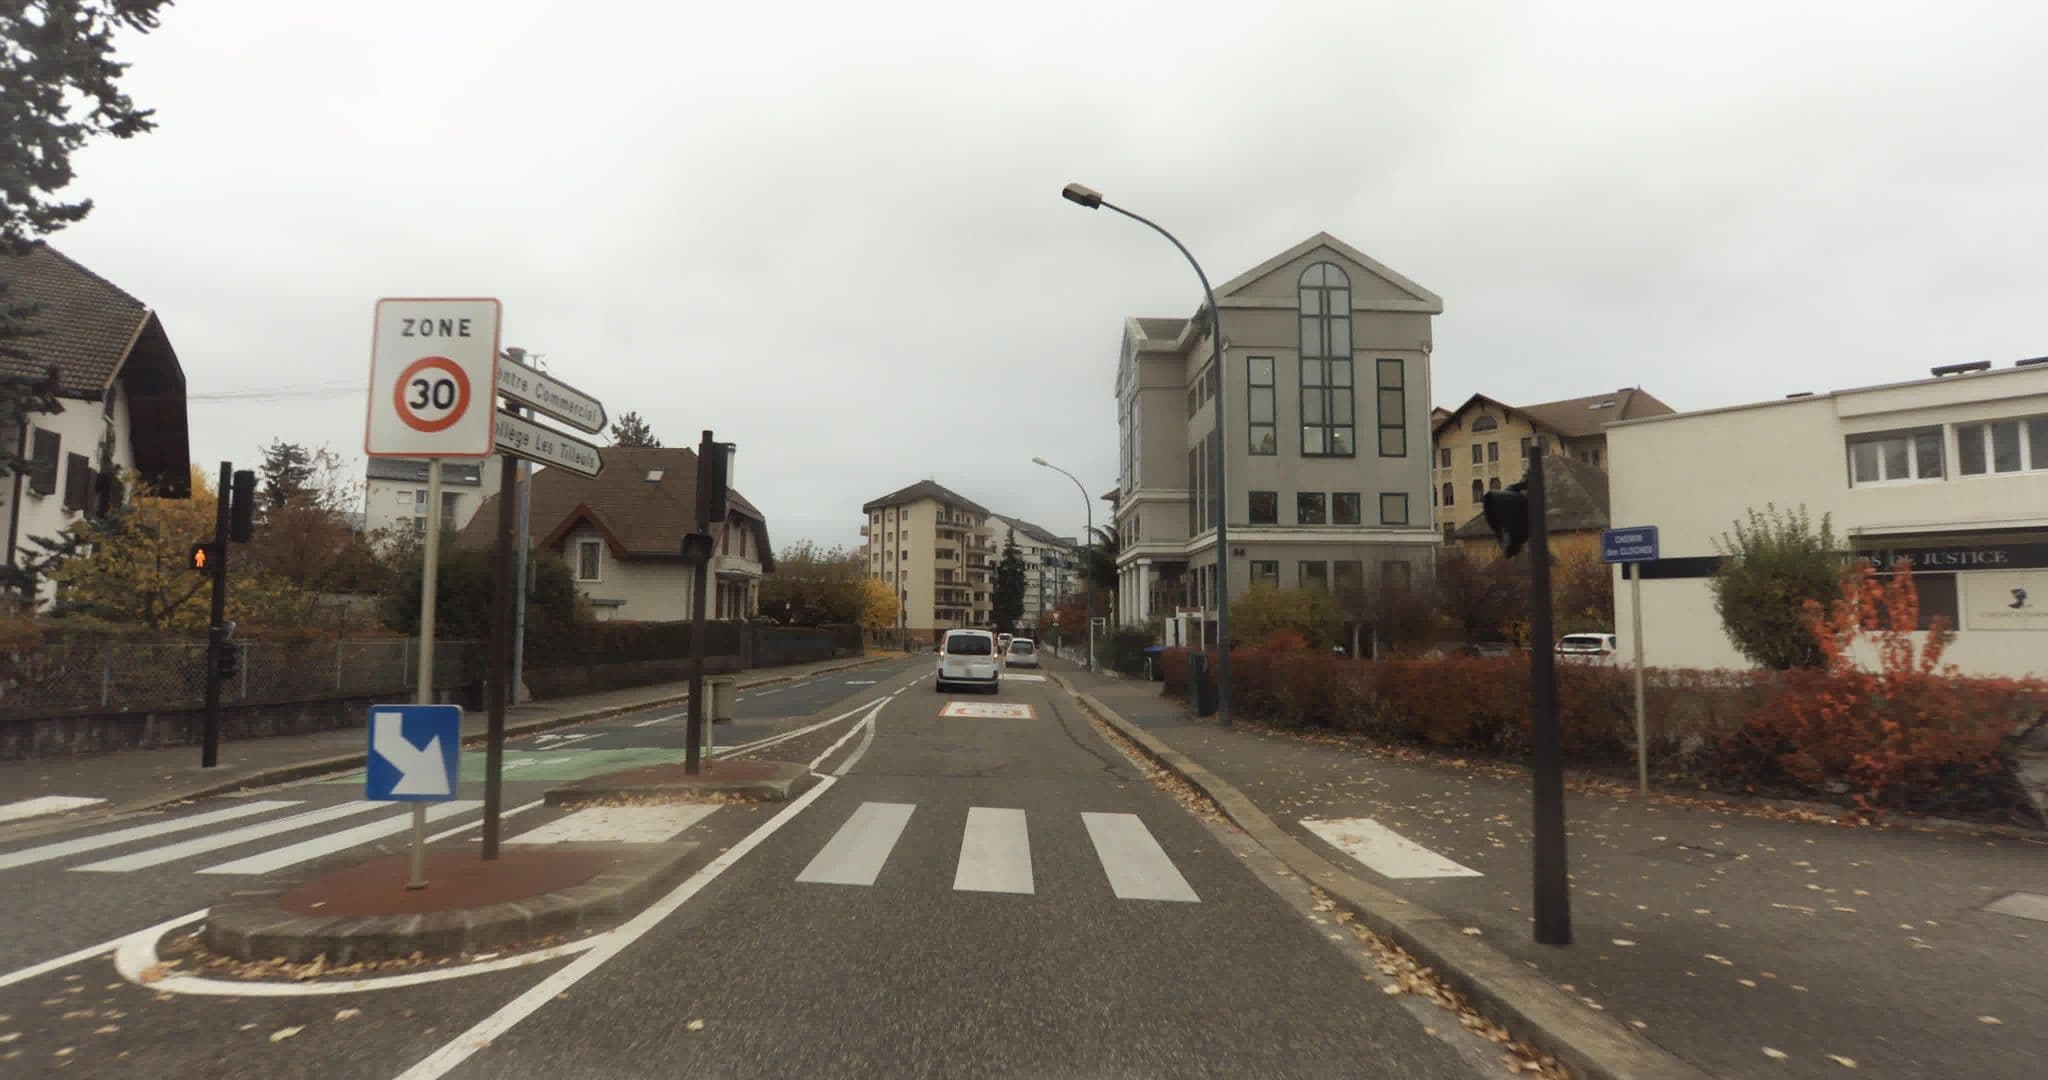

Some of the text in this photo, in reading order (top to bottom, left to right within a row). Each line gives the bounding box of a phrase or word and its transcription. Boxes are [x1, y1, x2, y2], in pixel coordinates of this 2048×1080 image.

[402, 318, 472, 337] ZONE
[409, 378, 456, 411] 30
[535, 382, 598, 423] Commercial
[536, 434, 553, 454] Les
[560, 442, 596, 469] Tilleuls
[1923, 550, 2009, 566] JUSTICE
